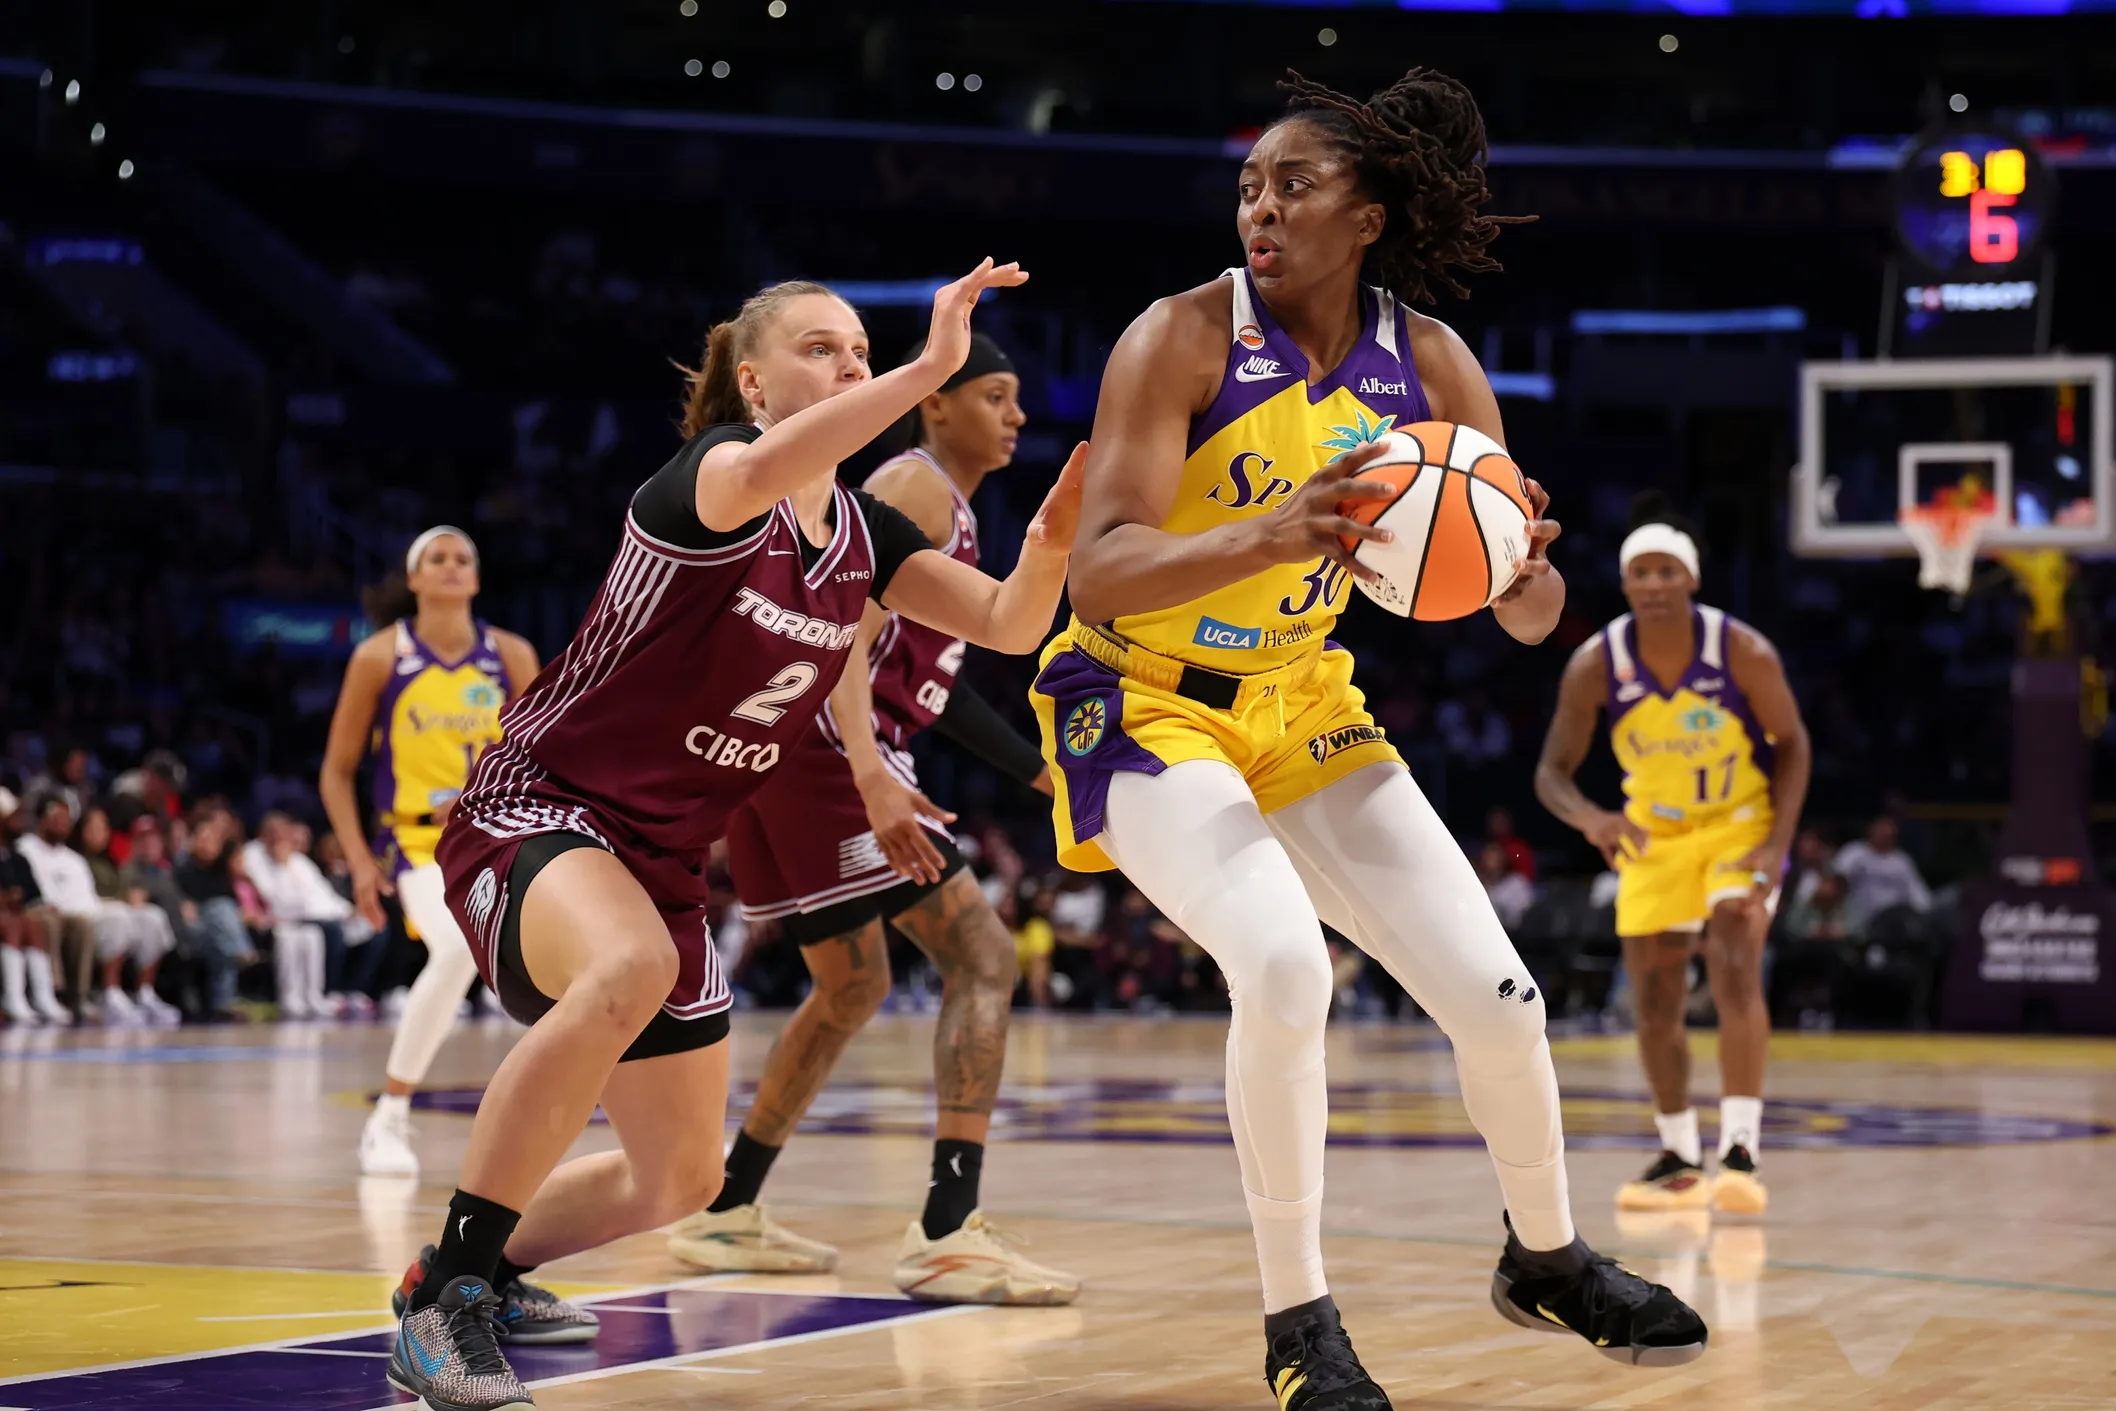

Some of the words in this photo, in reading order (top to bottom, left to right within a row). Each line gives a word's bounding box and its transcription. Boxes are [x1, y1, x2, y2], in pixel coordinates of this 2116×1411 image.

[1969, 188, 2019, 264] 6
[1244, 354, 1281, 375] NIKE
[1358, 377, 1408, 396] Albert
[1278, 555, 1349, 617] 30
[1203, 626, 1250, 648] UCLA
[1263, 620, 1313, 648] Health
[730, 661, 818, 727] 2
[1328, 726, 1386, 750] WNBA
[1692, 751, 1738, 804] 17
